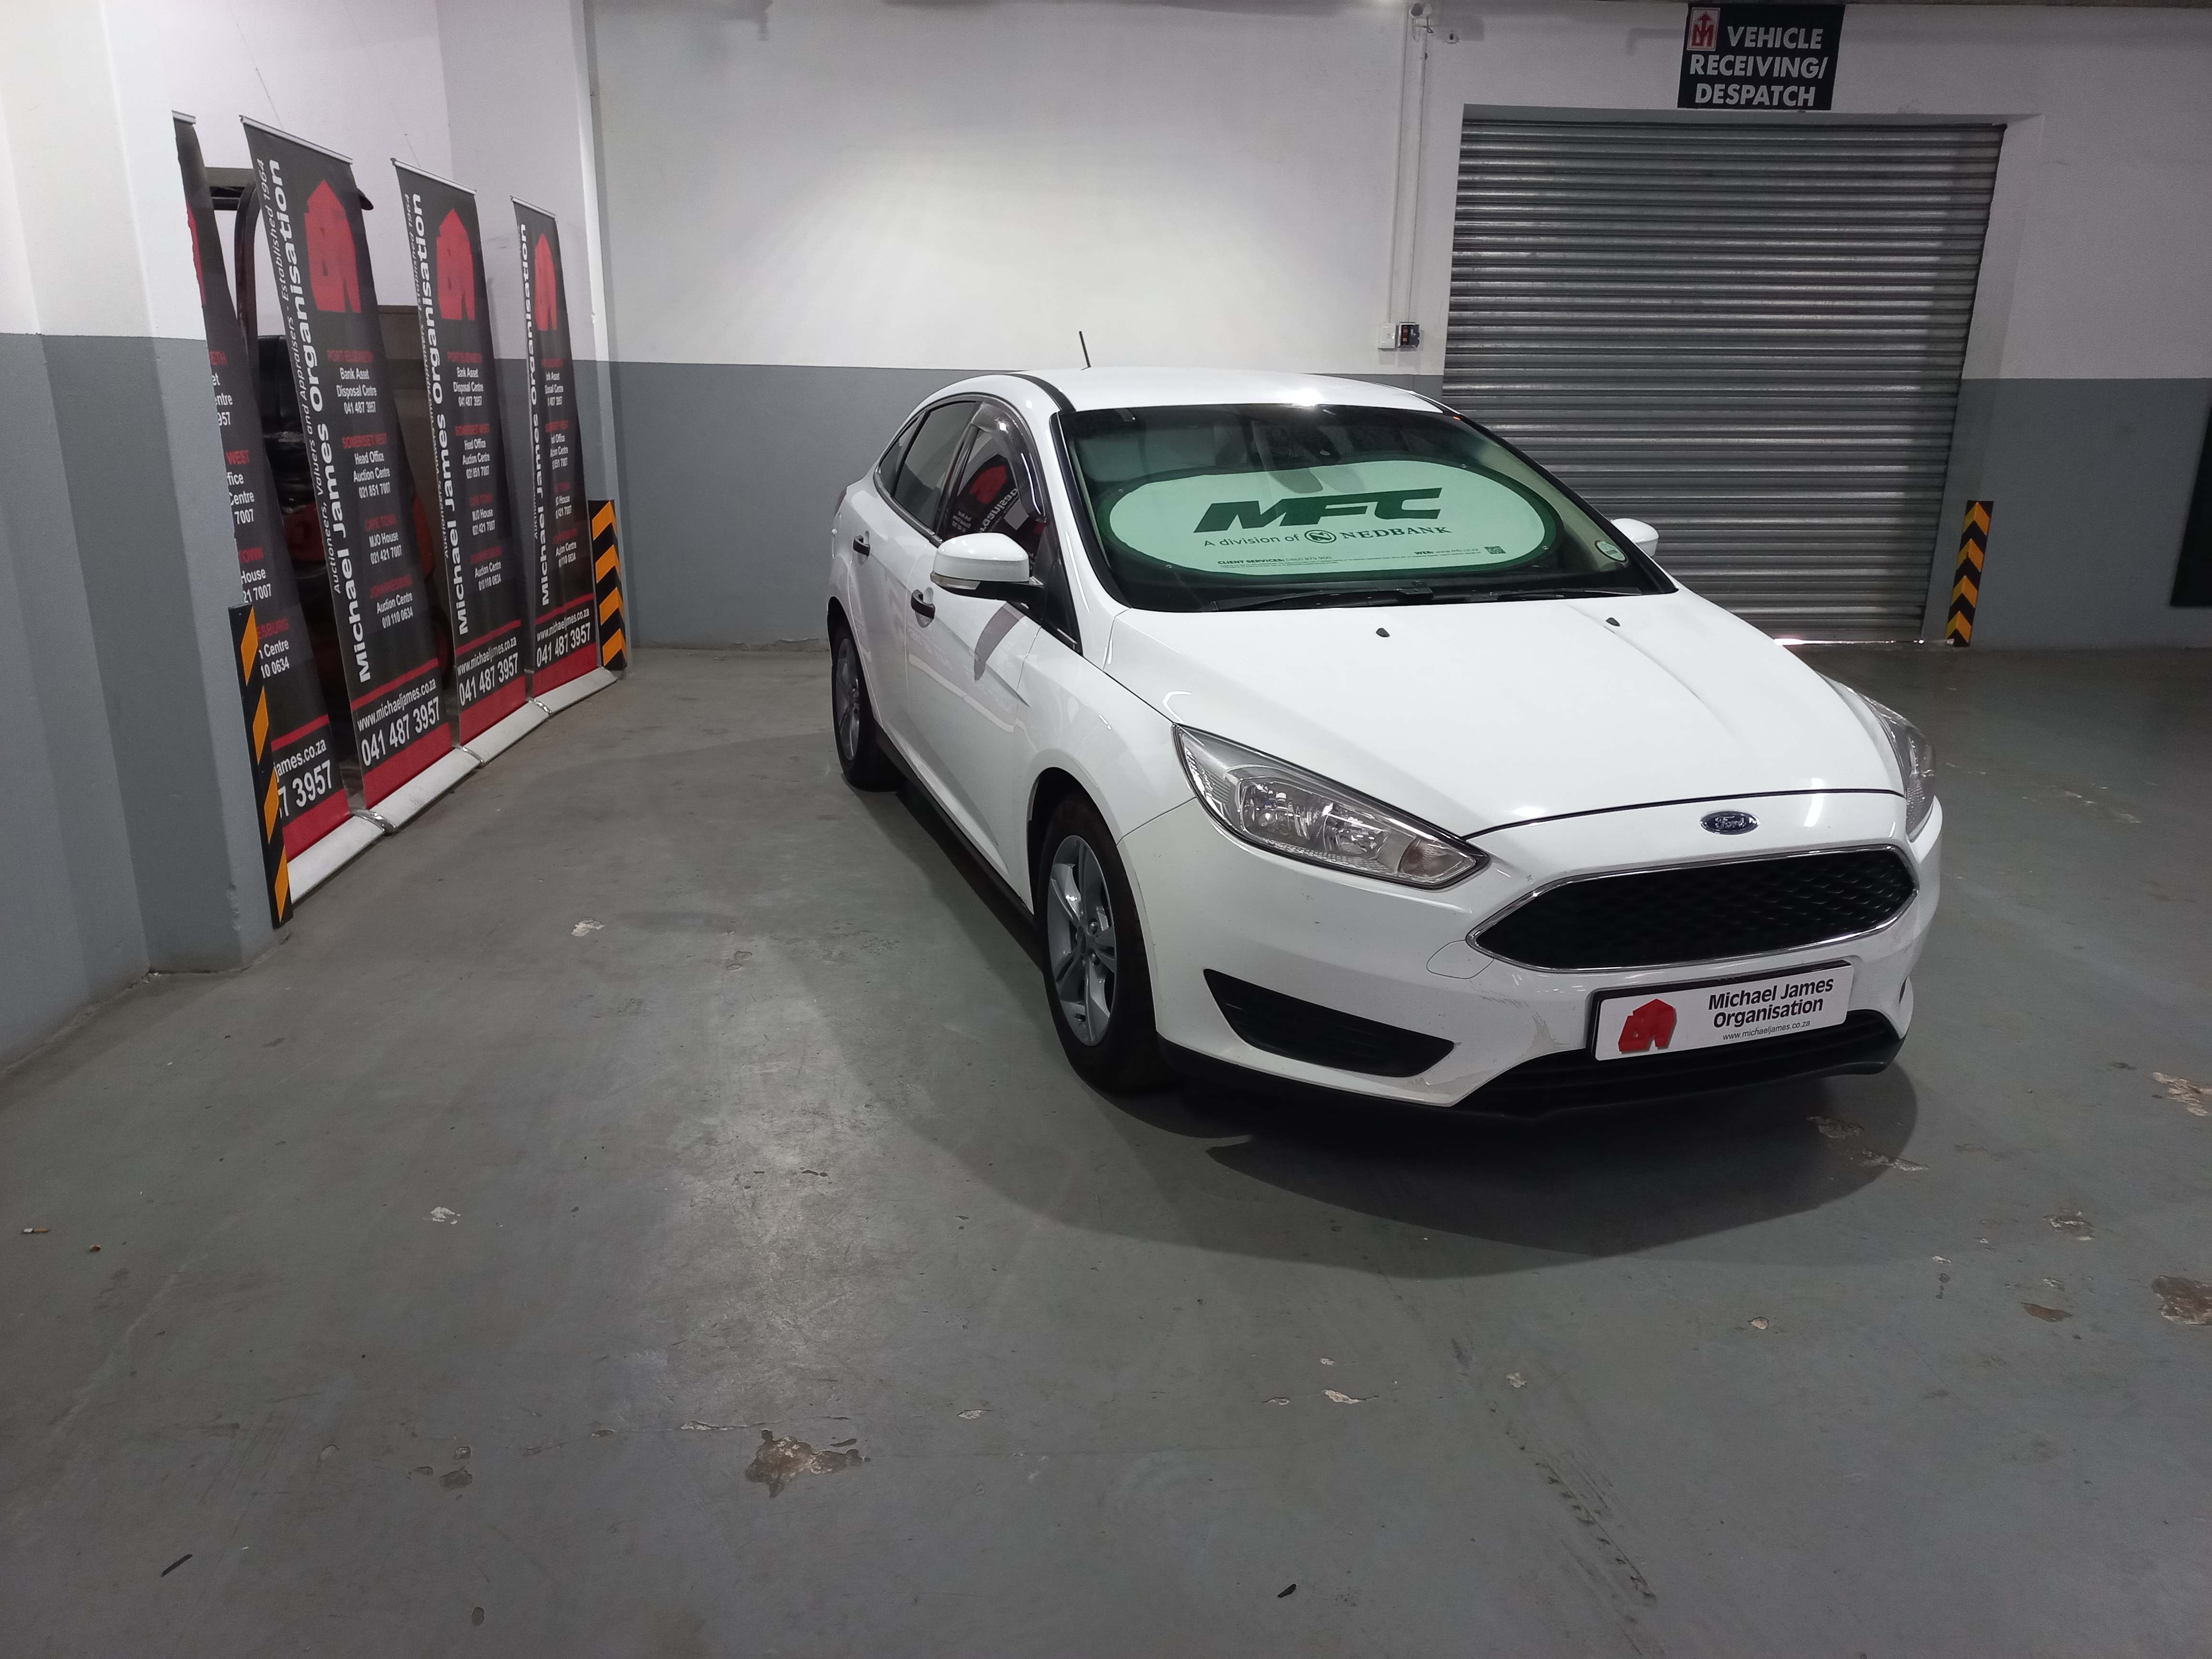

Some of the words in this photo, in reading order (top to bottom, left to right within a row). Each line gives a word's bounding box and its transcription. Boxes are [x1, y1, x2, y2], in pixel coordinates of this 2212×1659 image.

[1727, 26, 1824, 49] VEHICLE
[1690, 54, 1829, 79] RECEIVING/
[1695, 83, 1815, 107] DESPATCH
[257, 158, 270, 200] 1964
[265, 205, 289, 301] Established
[269, 159, 323, 412] Organisation
[413, 193, 442, 404] Organisation
[520, 223, 537, 406] Organisation
[287, 316, 307, 401] Appraisers
[340, 367, 355, 379] Bank
[336, 384, 362, 399] Disposal
[217, 412, 231, 426] 957
[302, 403, 313, 435] and
[344, 402, 354, 414] 041
[354, 401, 365, 413] 487
[309, 439, 323, 495] Valuers
[354, 452, 369, 465] Head
[369, 450, 384, 463] Office
[437, 414, 455, 512] James
[533, 414, 543, 498] James
[227, 472, 244, 486] fice
[317, 423, 346, 538] James
[354, 468, 374, 482] Auction
[375, 467, 390, 478] Centre
[359, 487, 368, 498] 021
[369, 484, 379, 497] 851
[234, 508, 254, 524] 7007
[1193, 487, 1442, 533] MFC
[369, 534, 381, 547] MJO
[381, 532, 398, 544] House
[1219, 536, 1281, 546] division
[1340, 527, 1452, 539] NEDBANK
[370, 553, 379, 564] 021
[380, 549, 390, 561] 421
[538, 506, 549, 606] Michael
[243, 589, 252, 603] 21
[253, 583, 271, 600] 7007
[447, 520, 468, 635] Michael
[337, 548, 371, 683] Michael
[376, 598, 396, 614] Auction
[396, 592, 413, 606] Centre
[391, 610, 400, 624] 110
[401, 606, 413, 620] 0634
[264, 640, 289, 657] Centre
[537, 642, 551, 667] 041
[555, 633, 568, 657] 487
[570, 622, 590, 649] 3957
[271, 656, 290, 675] 0634
[459, 676, 476, 706] 041
[479, 665, 495, 693] 487
[497, 652, 518, 683] 3957
[357, 678, 436, 732] www.michaeljames.co.za
[361, 729, 386, 766] 041
[389, 713, 409, 747] 487
[413, 696, 440, 733] 3957
[273, 739, 327, 783] james.co.za
[292, 760, 332, 807] 3957
[1708, 985, 1777, 1010] Michael
[1781, 978, 1834, 999] James
[1714, 998, 1824, 1028] Organisation
[1722, 1019, 1810, 1040] www.michaeljames.co.za
